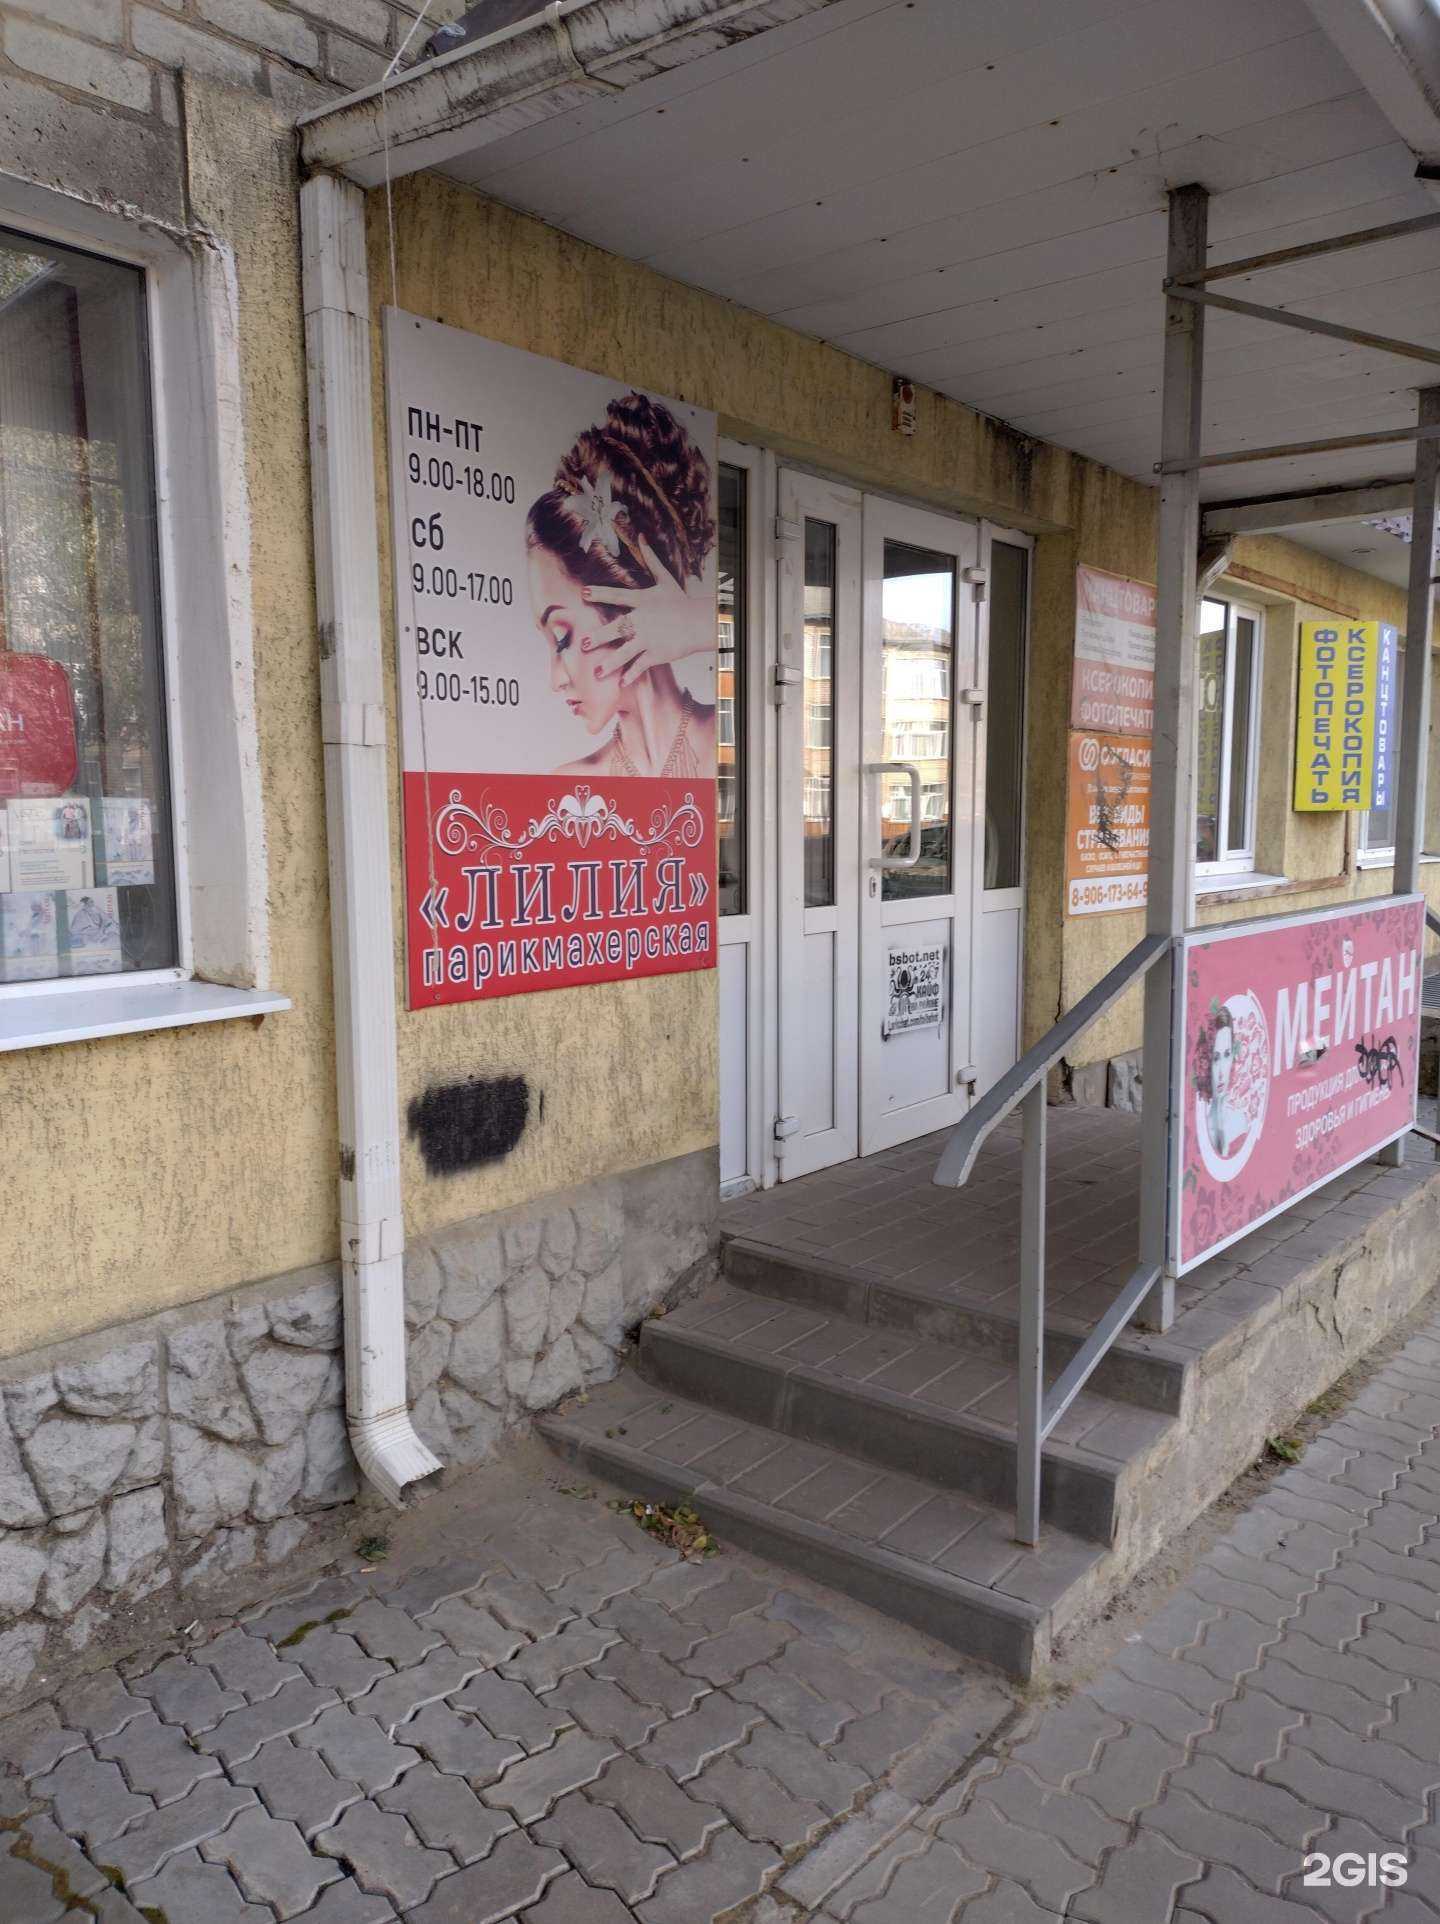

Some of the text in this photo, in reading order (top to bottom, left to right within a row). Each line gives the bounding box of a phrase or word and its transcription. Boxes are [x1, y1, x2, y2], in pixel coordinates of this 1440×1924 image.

[409, 453, 515, 504] 9.00-18.00
[413, 563, 513, 606] 9.00-17.00
[417, 670, 519, 706] 9.00-15.00
[1082, 668, 1153, 699] КСЕРОКОПИ
[1080, 702, 1153, 729] ФОТОПЕЧАТ
[1311, 629, 1338, 804] ФОТОПЕЧАТЬ
[1341, 628, 1366, 804] КСЕРОКОПИЯ
[419, 858, 709, 931] «ЛИЛИЯ»
[422, 922, 709, 989] парикмахерская
[889, 950, 940, 966] bsbot.net
[1273, 940, 1417, 1077] МЕЙТАН
